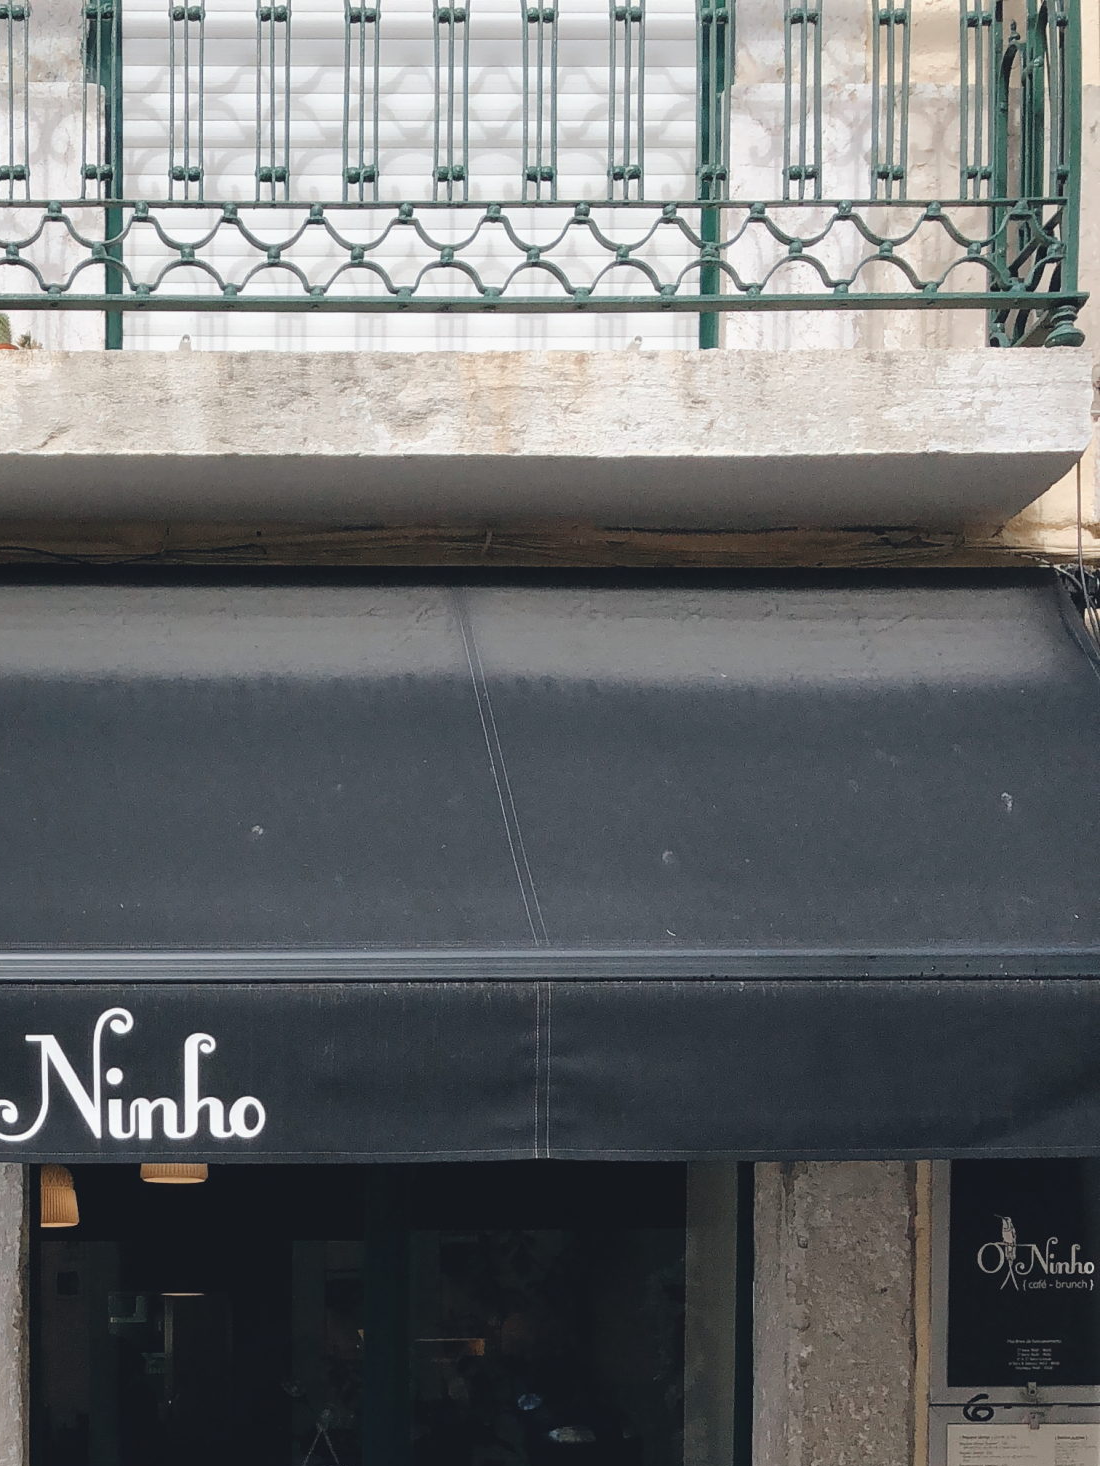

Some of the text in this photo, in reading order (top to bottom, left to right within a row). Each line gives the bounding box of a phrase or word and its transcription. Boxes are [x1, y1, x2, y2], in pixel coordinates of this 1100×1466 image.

[977, 1236, 1095, 1275] O Ninho
[1028, 1280, 1047, 1289] café
[1055, 1280, 1088, 1289] brunch
[962, 1393, 995, 1422] 6
